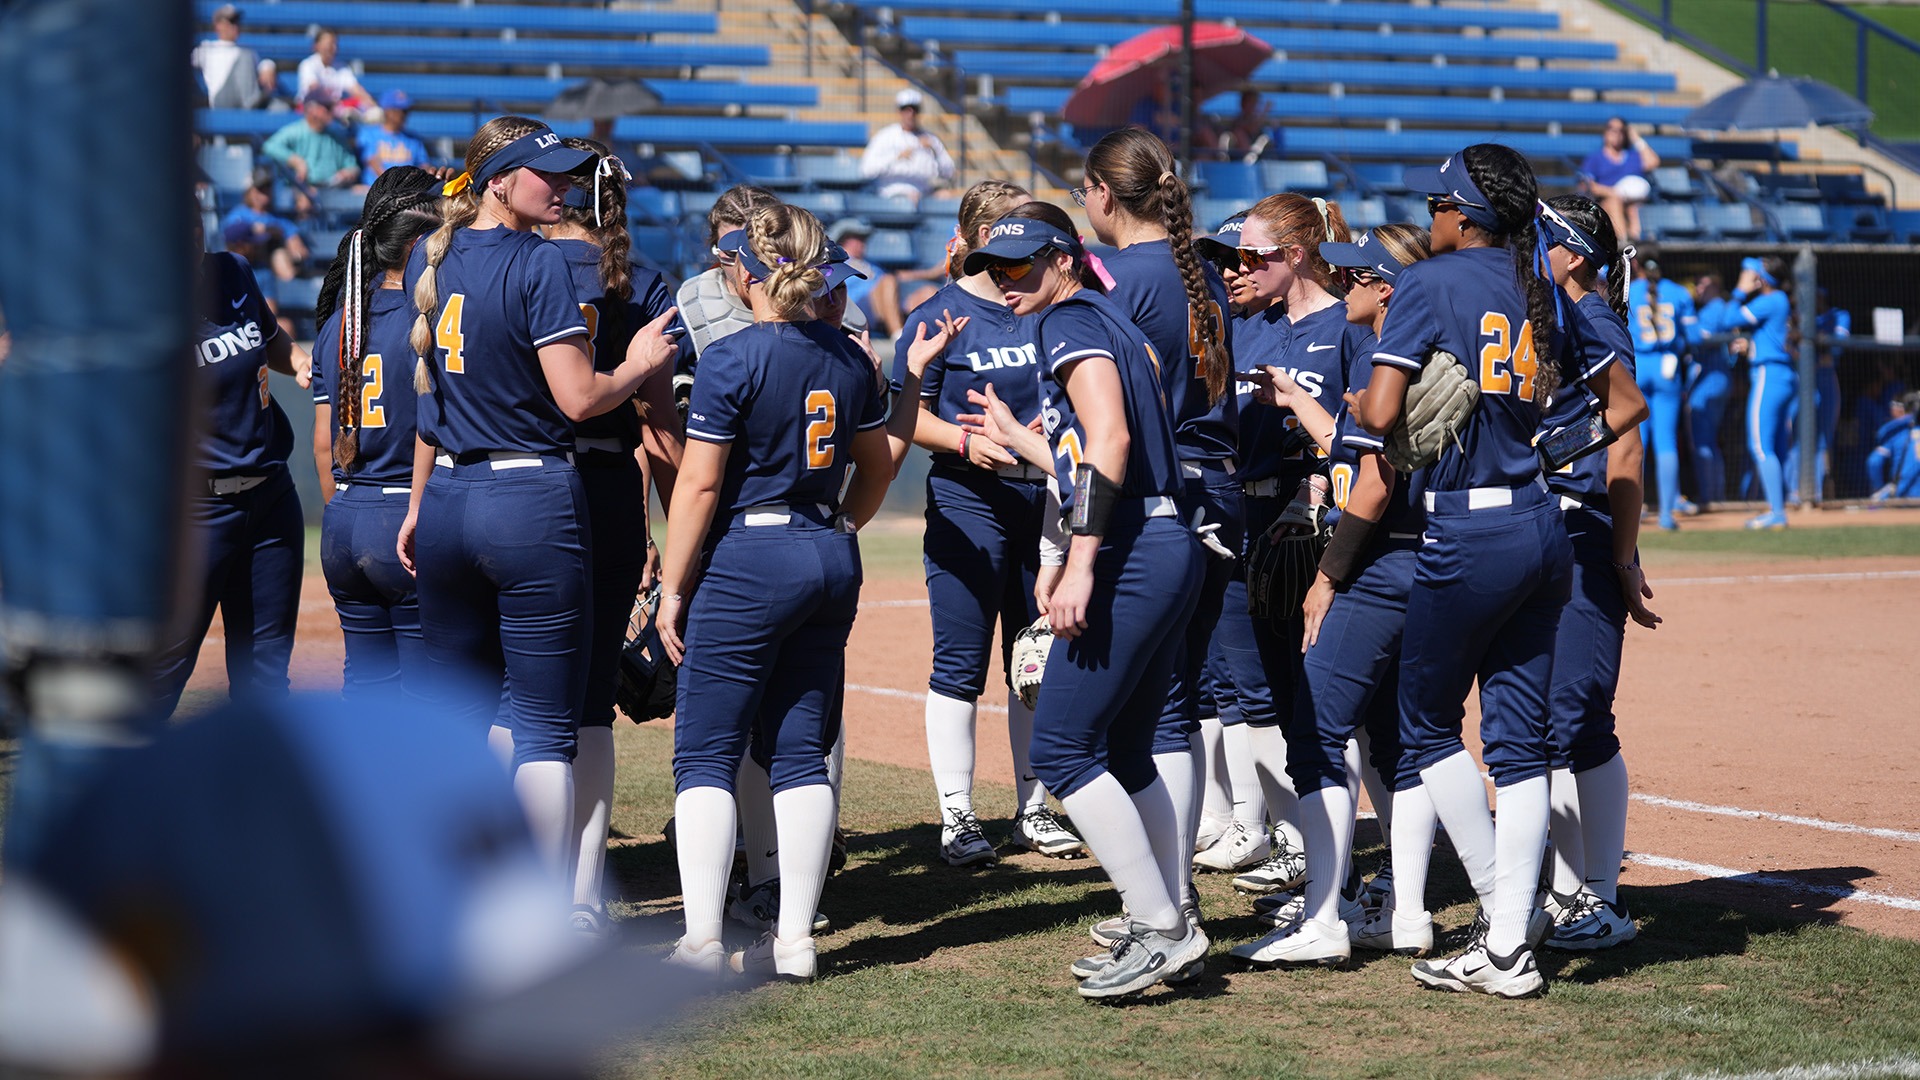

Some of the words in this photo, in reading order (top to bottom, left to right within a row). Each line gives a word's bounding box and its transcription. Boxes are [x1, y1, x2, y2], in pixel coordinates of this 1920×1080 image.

[1217, 222, 1244, 236] ONS
[436, 293, 465, 374] 4
[1480, 311, 1540, 403] 24
[347, 353, 387, 428] 2
[805, 389, 836, 470] 2
